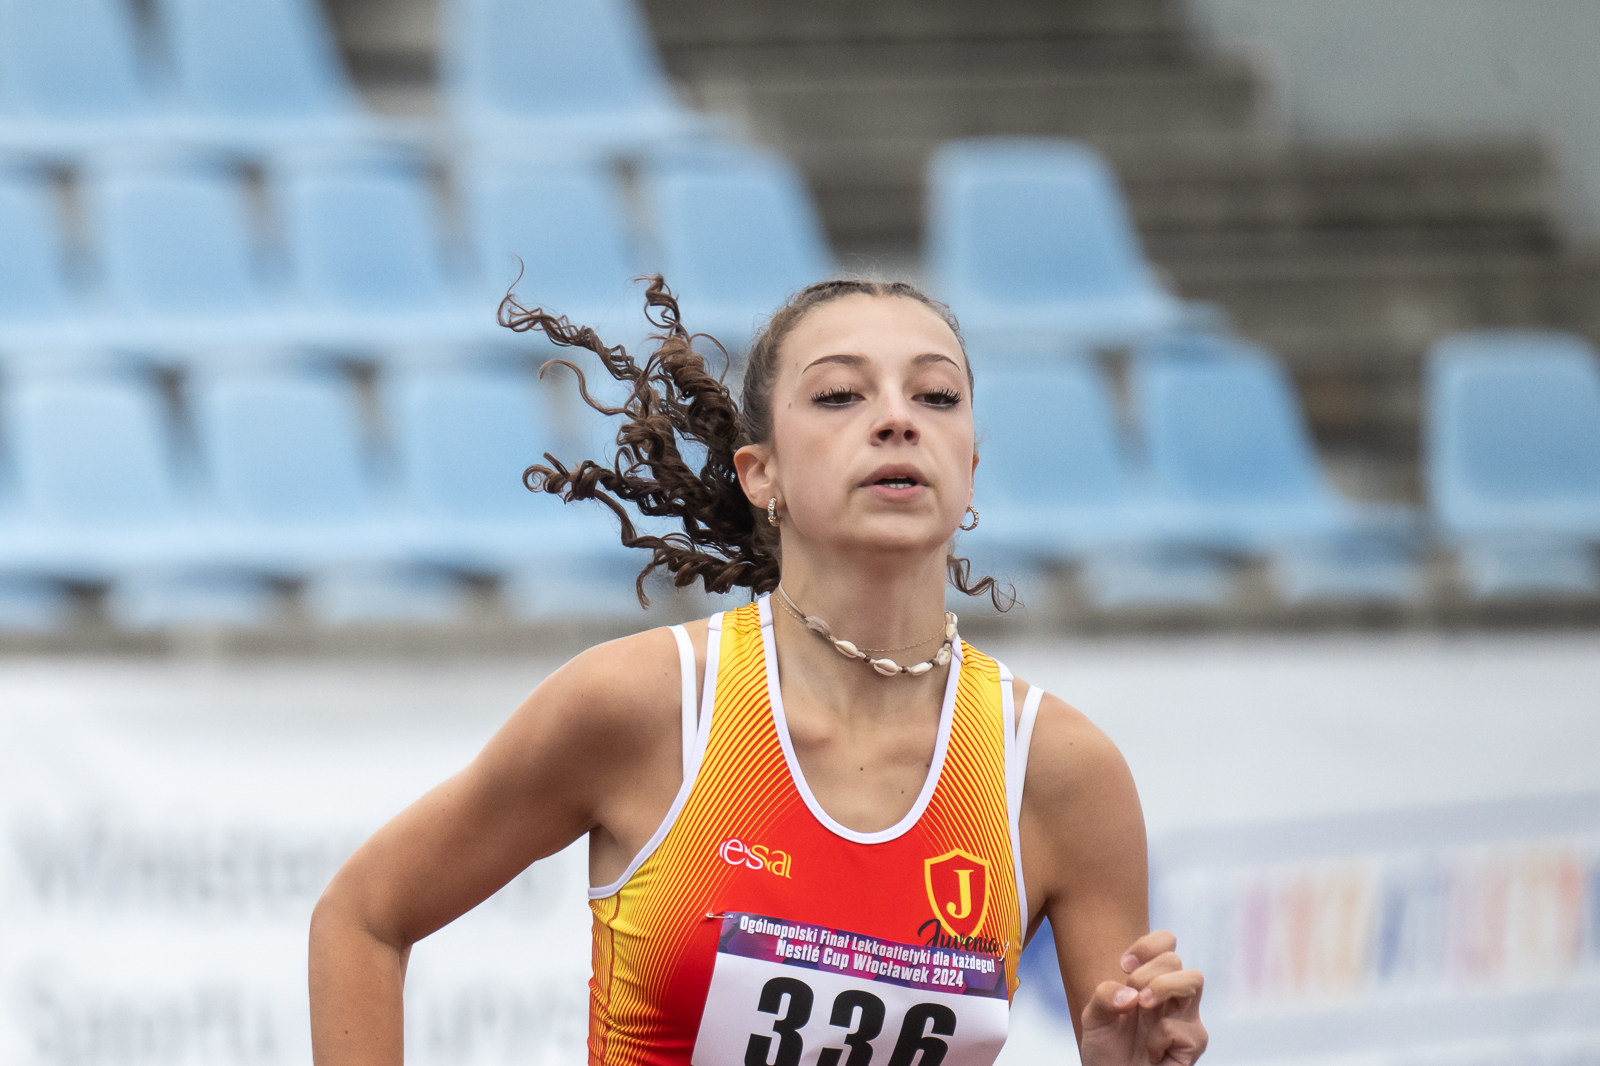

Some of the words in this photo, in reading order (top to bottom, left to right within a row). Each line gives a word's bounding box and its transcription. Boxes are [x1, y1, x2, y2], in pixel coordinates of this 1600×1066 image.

[946, 869, 975, 919] J
[739, 915, 819, 943] Ogólnopolski
[820, 930, 850, 949] Finał
[851, 934, 931, 966] Lekkoatletyki
[933, 951, 950, 967] dla
[952, 953, 996, 974] każdego!
[917, 918, 1001, 954] Juvenia
[775, 939, 821, 963] Nestlé
[822, 948, 850, 970] Cup
[853, 952, 930, 984] Włocławek
[931, 967, 964, 988] 2024
